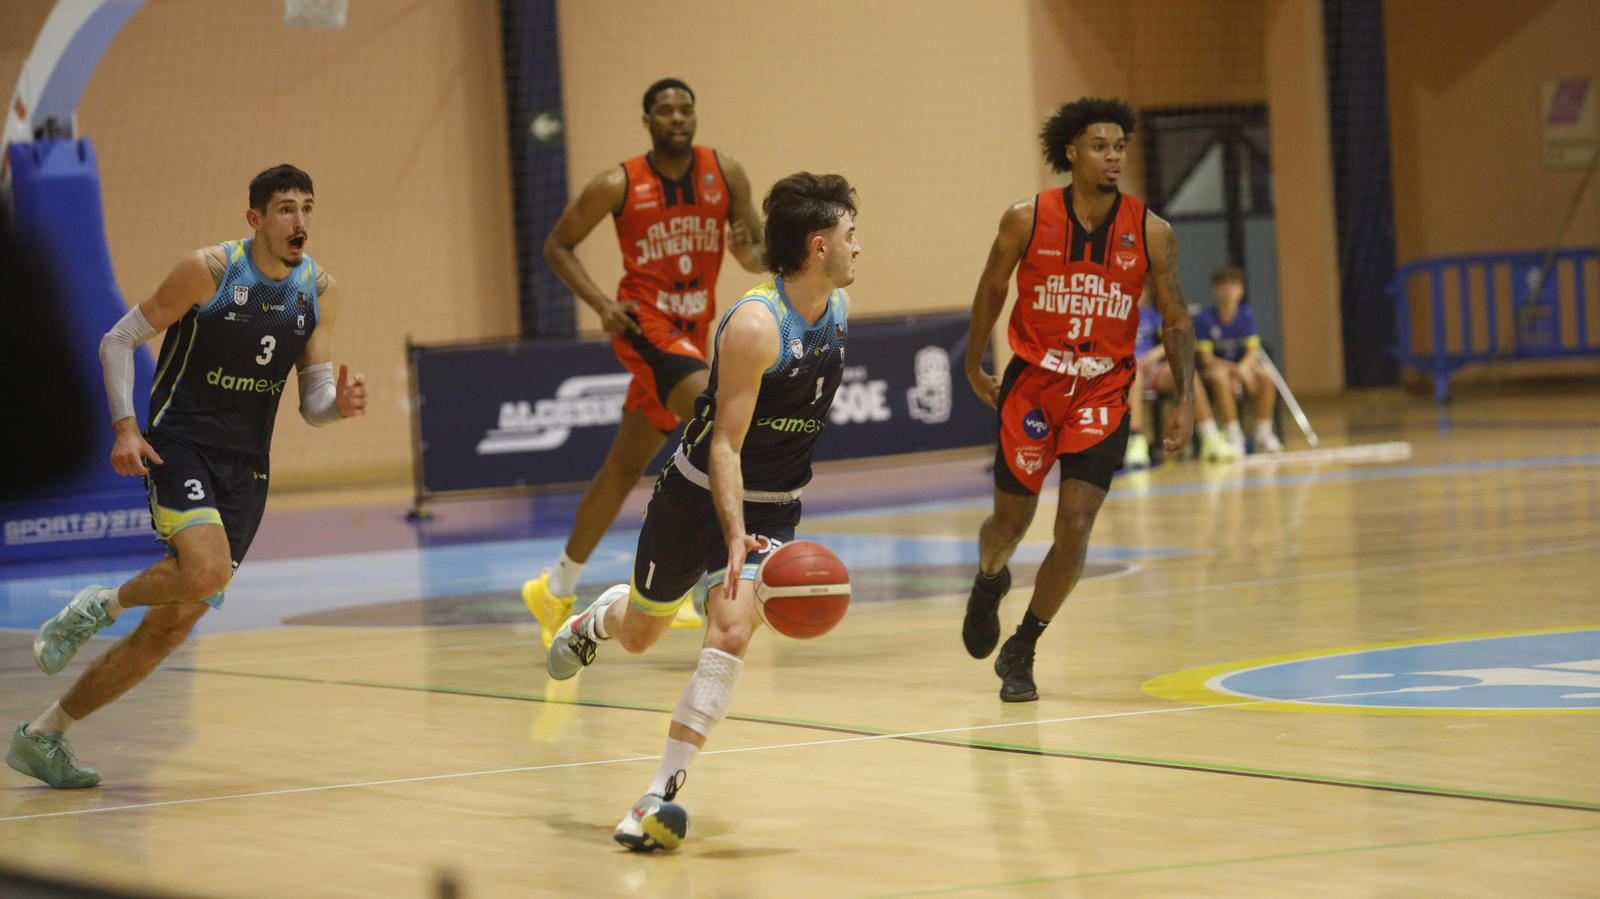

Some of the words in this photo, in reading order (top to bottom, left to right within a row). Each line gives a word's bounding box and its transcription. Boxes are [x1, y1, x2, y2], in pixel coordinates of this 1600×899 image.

[647, 215, 718, 242] ALCALA
[679, 254, 692, 276] 0
[1046, 273, 1122, 301] ALCALA
[1032, 285, 1133, 321] JUVENTUD
[1067, 317, 1094, 340] 31
[255, 335, 277, 366] 3
[810, 376, 825, 405] 1
[1077, 406, 1109, 426] 31
[184, 479, 206, 500] 3
[645, 560, 656, 590] 1
